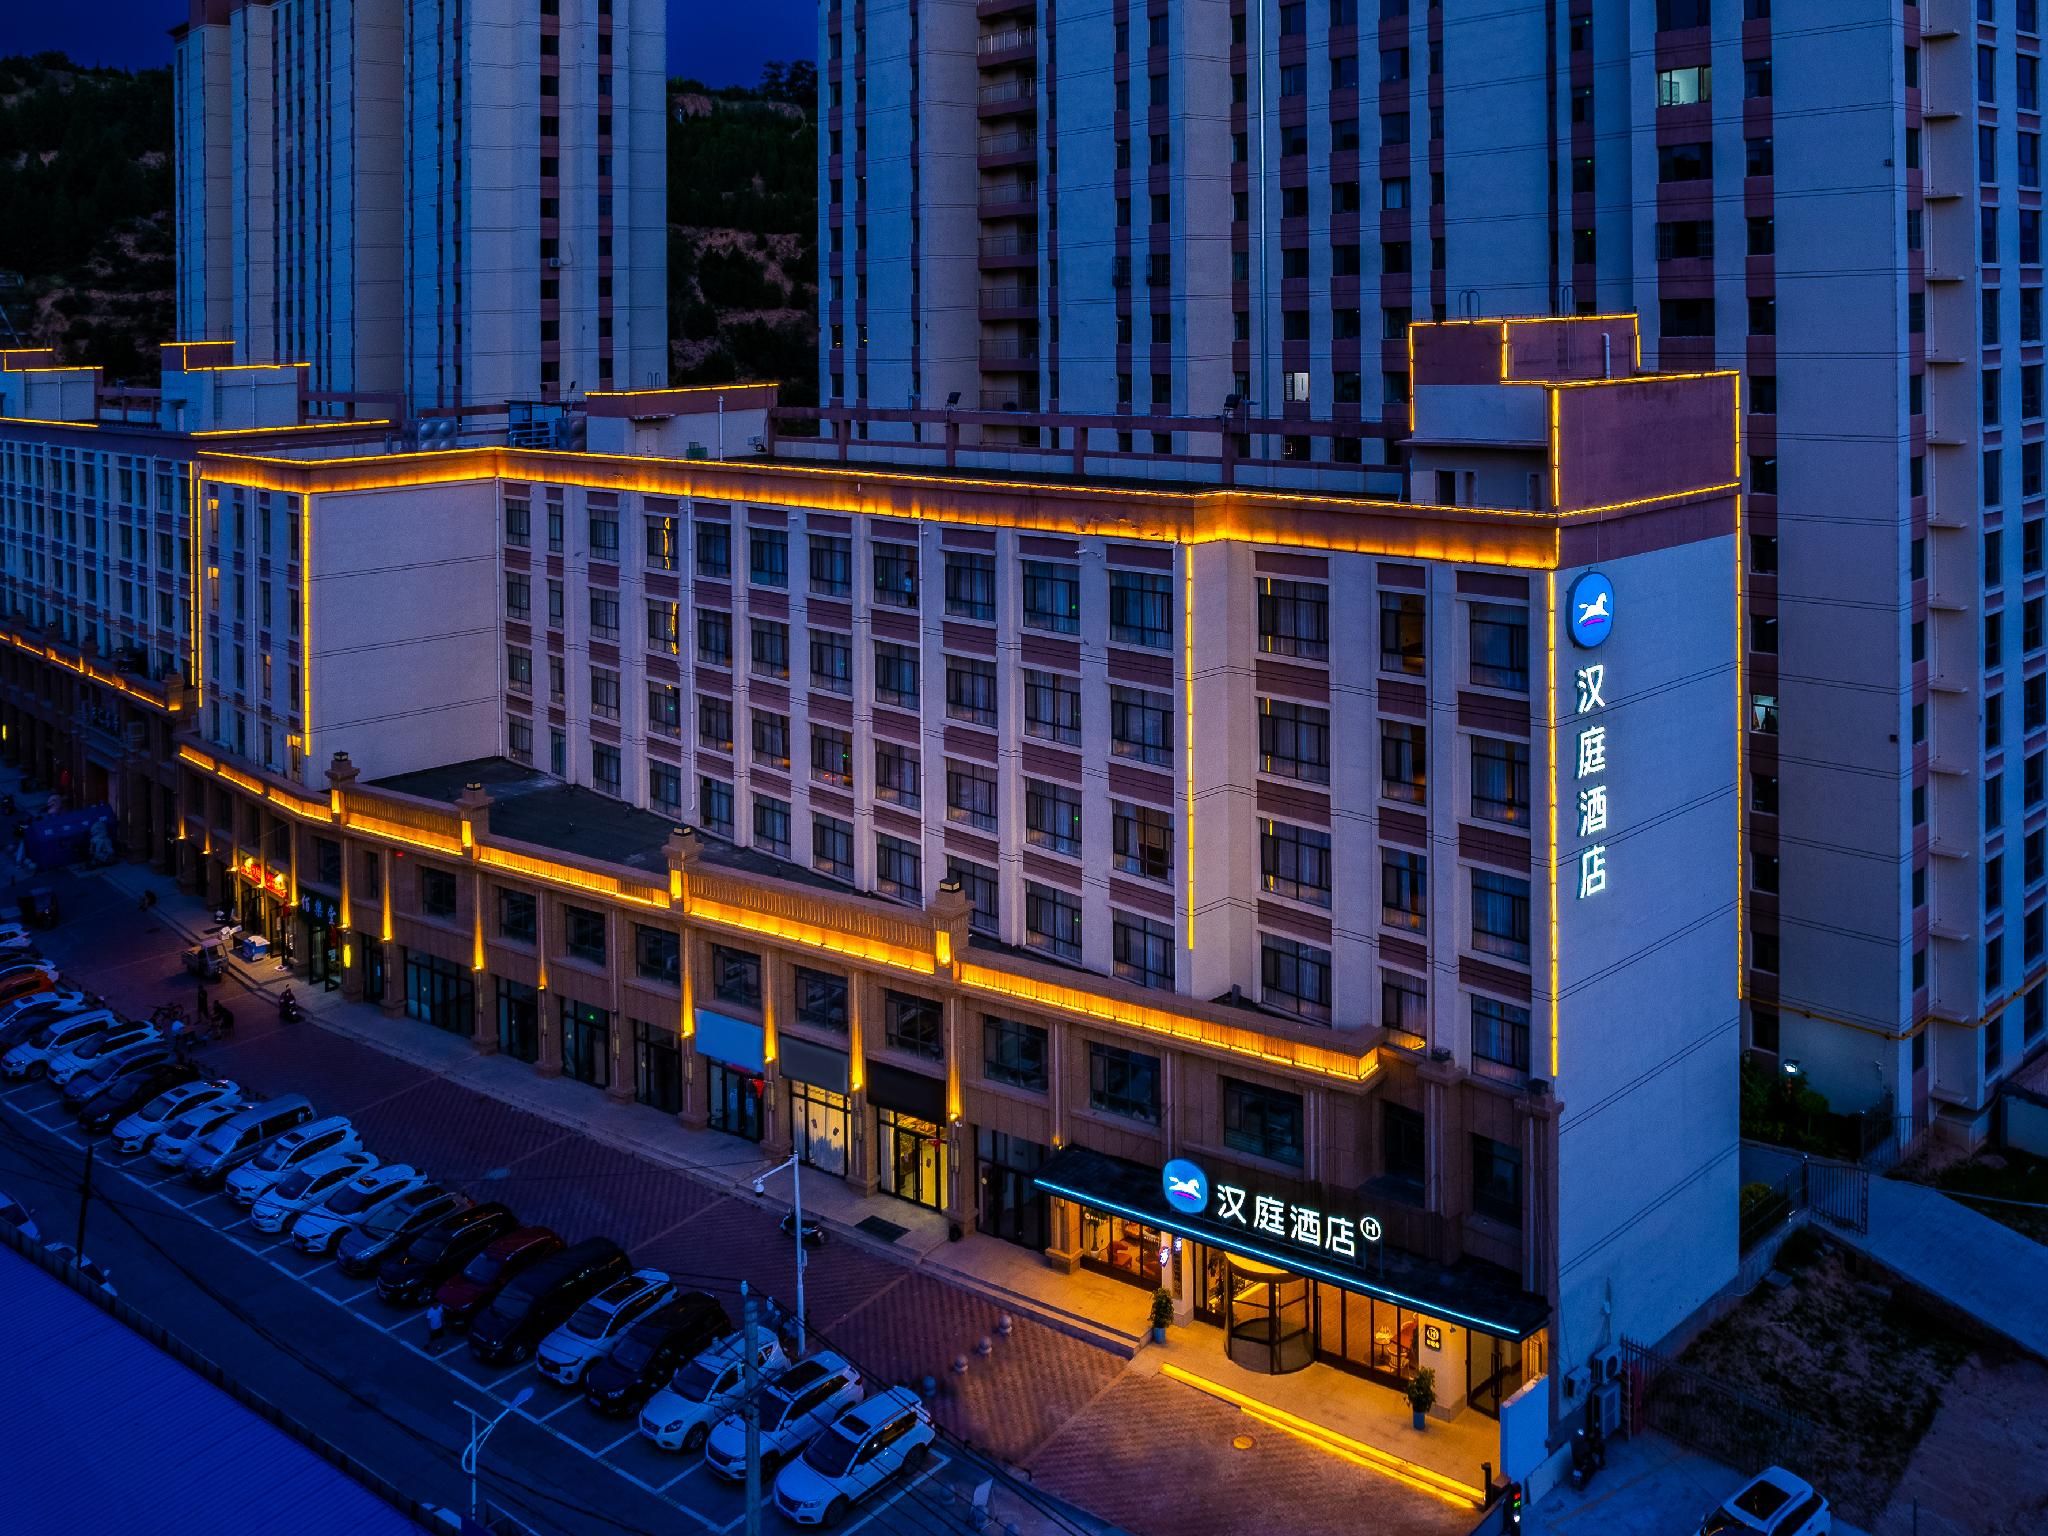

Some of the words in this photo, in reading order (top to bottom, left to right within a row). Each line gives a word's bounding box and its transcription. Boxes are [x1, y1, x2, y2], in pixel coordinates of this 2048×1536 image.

[1576, 664, 1607, 899] 汉庭酒店
[1217, 1184, 1355, 1257] 汉庭酒店
